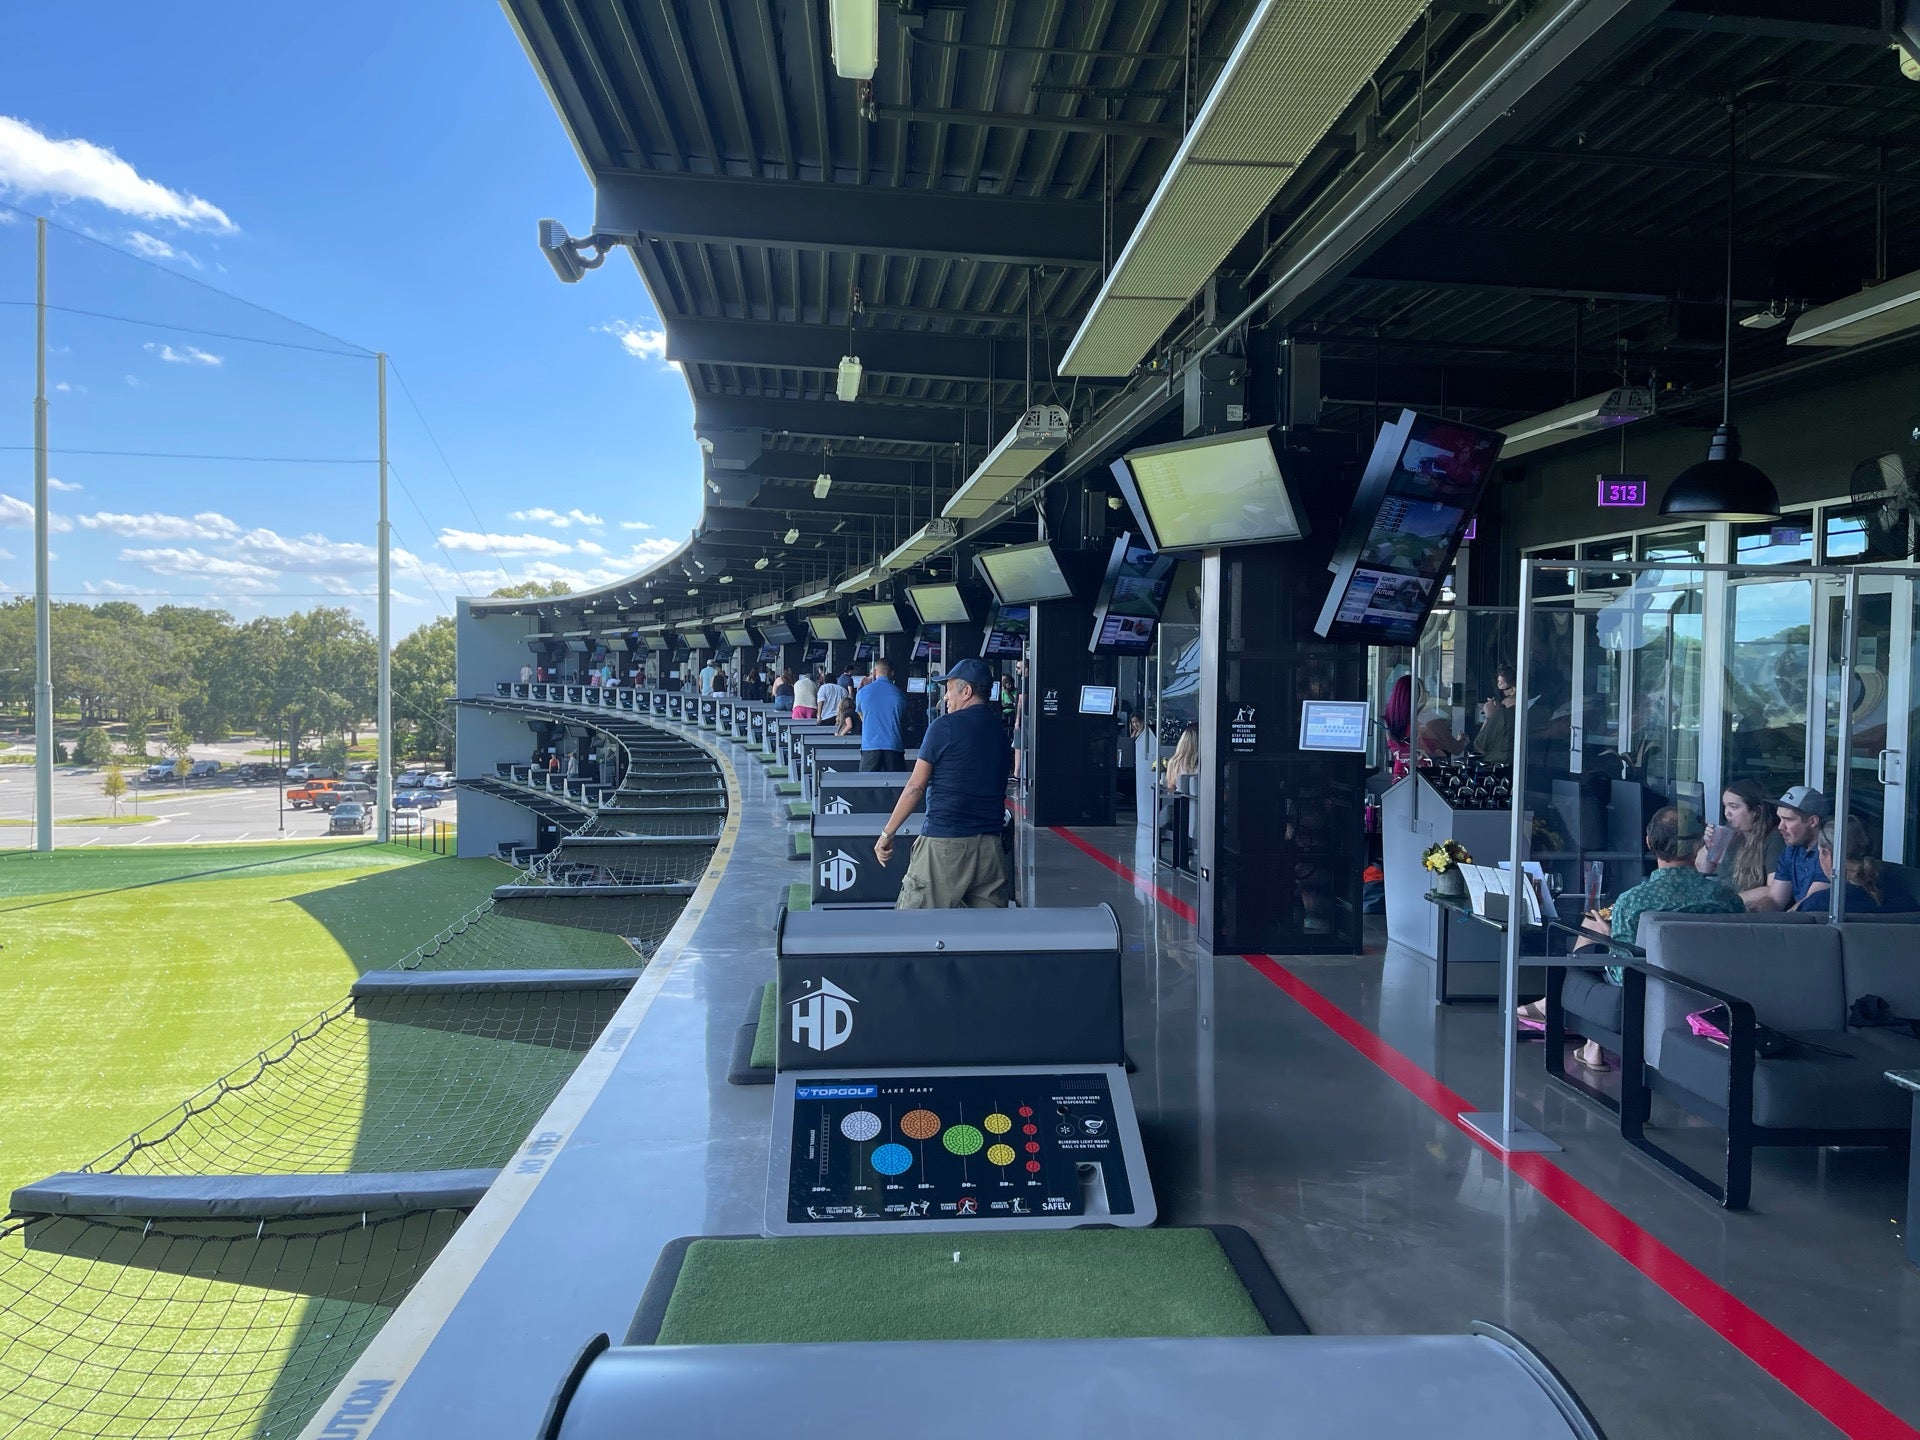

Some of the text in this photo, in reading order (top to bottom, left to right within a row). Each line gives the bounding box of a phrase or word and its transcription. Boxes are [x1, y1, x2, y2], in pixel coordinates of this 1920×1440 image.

[1609, 485, 1637, 501] 313
[820, 859, 857, 892] HD
[791, 993, 853, 1051] HD
[810, 1087, 874, 1096] TOPGOLF
[514, 1158, 546, 1175] NO
[1042, 1202, 1072, 1211] SAFELY
